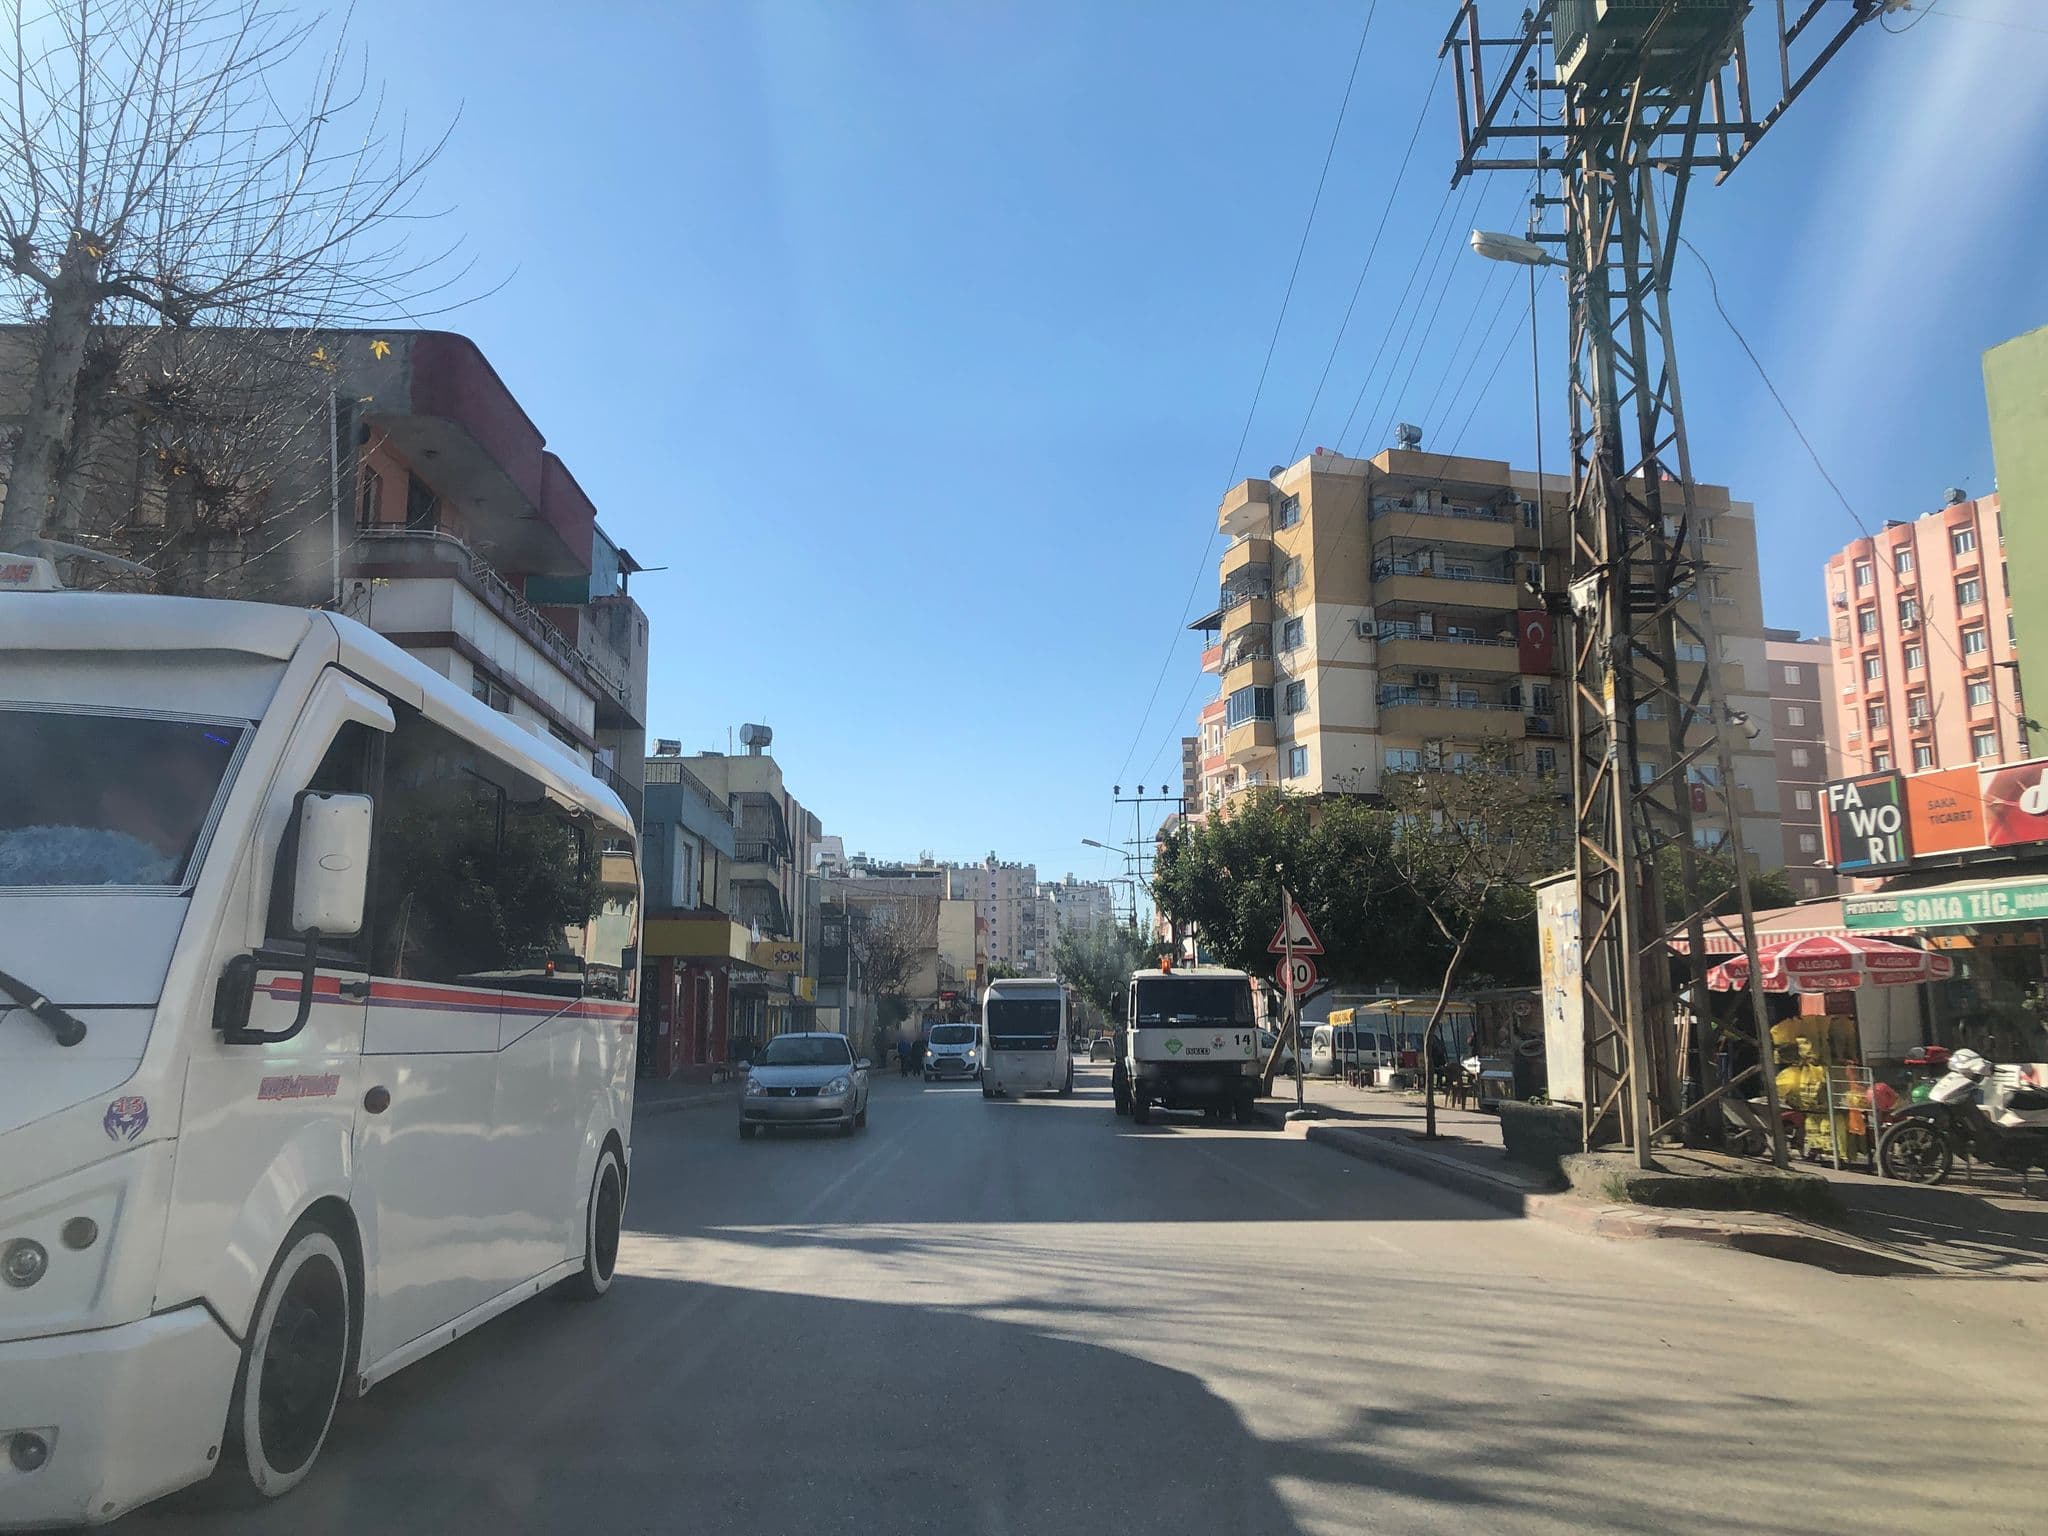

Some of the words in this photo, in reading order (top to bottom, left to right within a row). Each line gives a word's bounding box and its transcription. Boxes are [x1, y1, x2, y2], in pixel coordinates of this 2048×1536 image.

[1829, 783, 1863, 812] FA
[1928, 796, 1957, 810] SAKA
[1849, 804, 1902, 837] WO
[1868, 835, 1896, 864] RI
[1902, 896, 1964, 922] SAKA
[1797, 959, 1841, 970] ALGIDA
[1874, 957, 1912, 967] ALGIDA
[1234, 1034, 1250, 1046] 14
